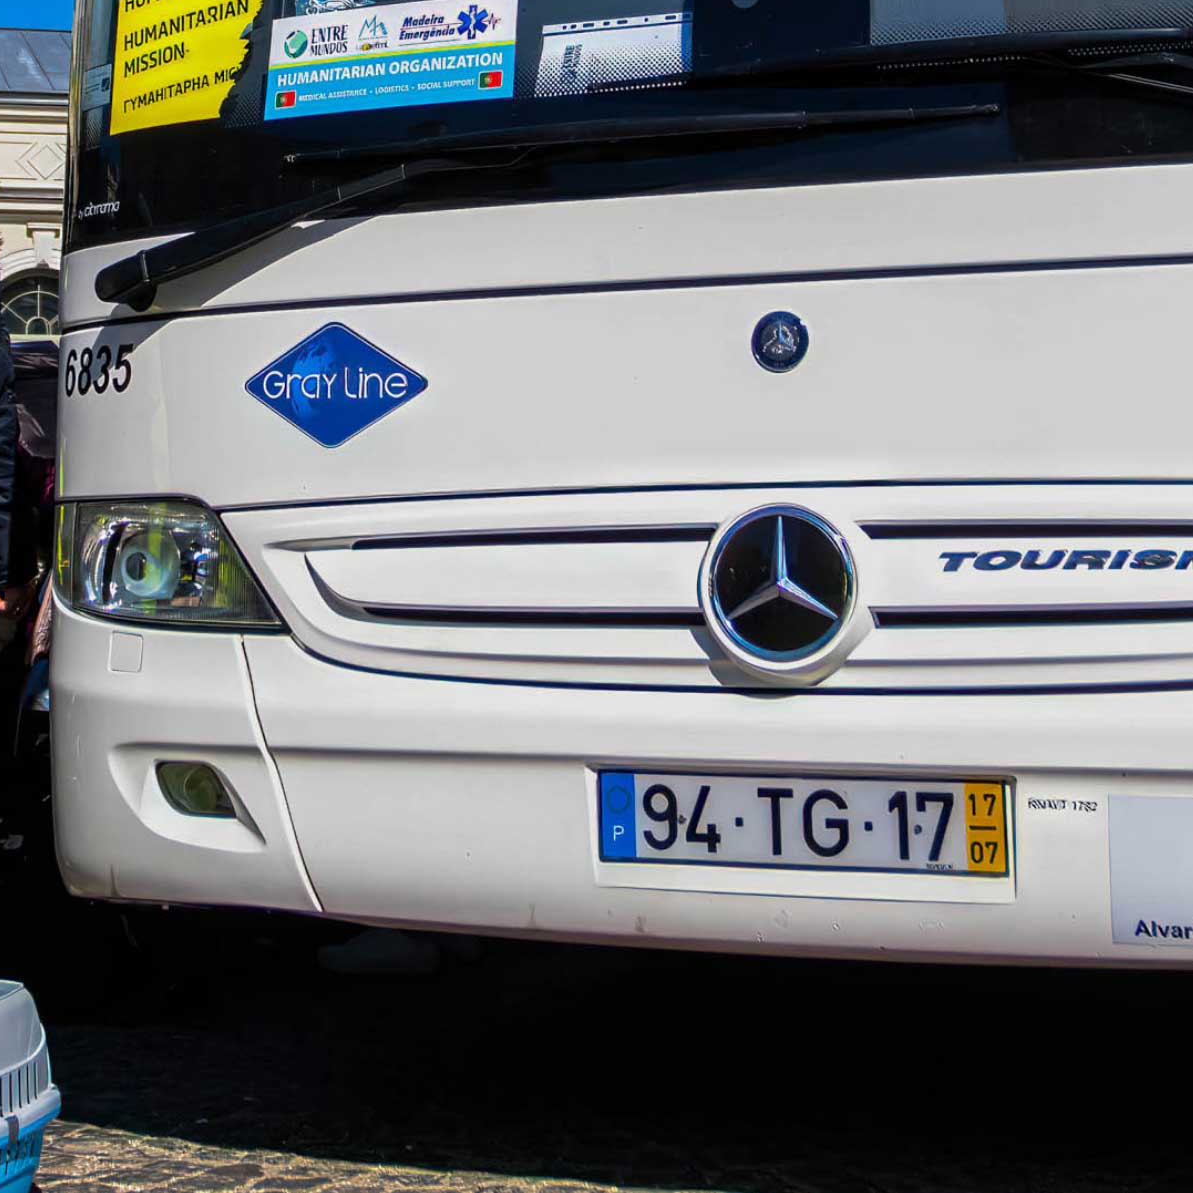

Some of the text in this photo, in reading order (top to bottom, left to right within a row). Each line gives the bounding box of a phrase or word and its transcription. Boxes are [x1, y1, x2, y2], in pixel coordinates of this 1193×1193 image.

[403, 14, 445, 27] Madeira
[311, 25, 348, 44] ENTRE
[399, 25, 455, 42] Emergência
[310, 41, 348, 56] MUNDOS
[277, 52, 503, 87] HUMANITARIAN ORGANIZATION
[417, 81, 442, 90] SOCIAL
[443, 78, 475, 88] SUPPORT
[65, 343, 135, 397] 6835
[263, 366, 408, 399] Gray Line
[968, 793, 997, 816] 17
[613, 825, 625, 841] P
[970, 841, 998, 864] 07
